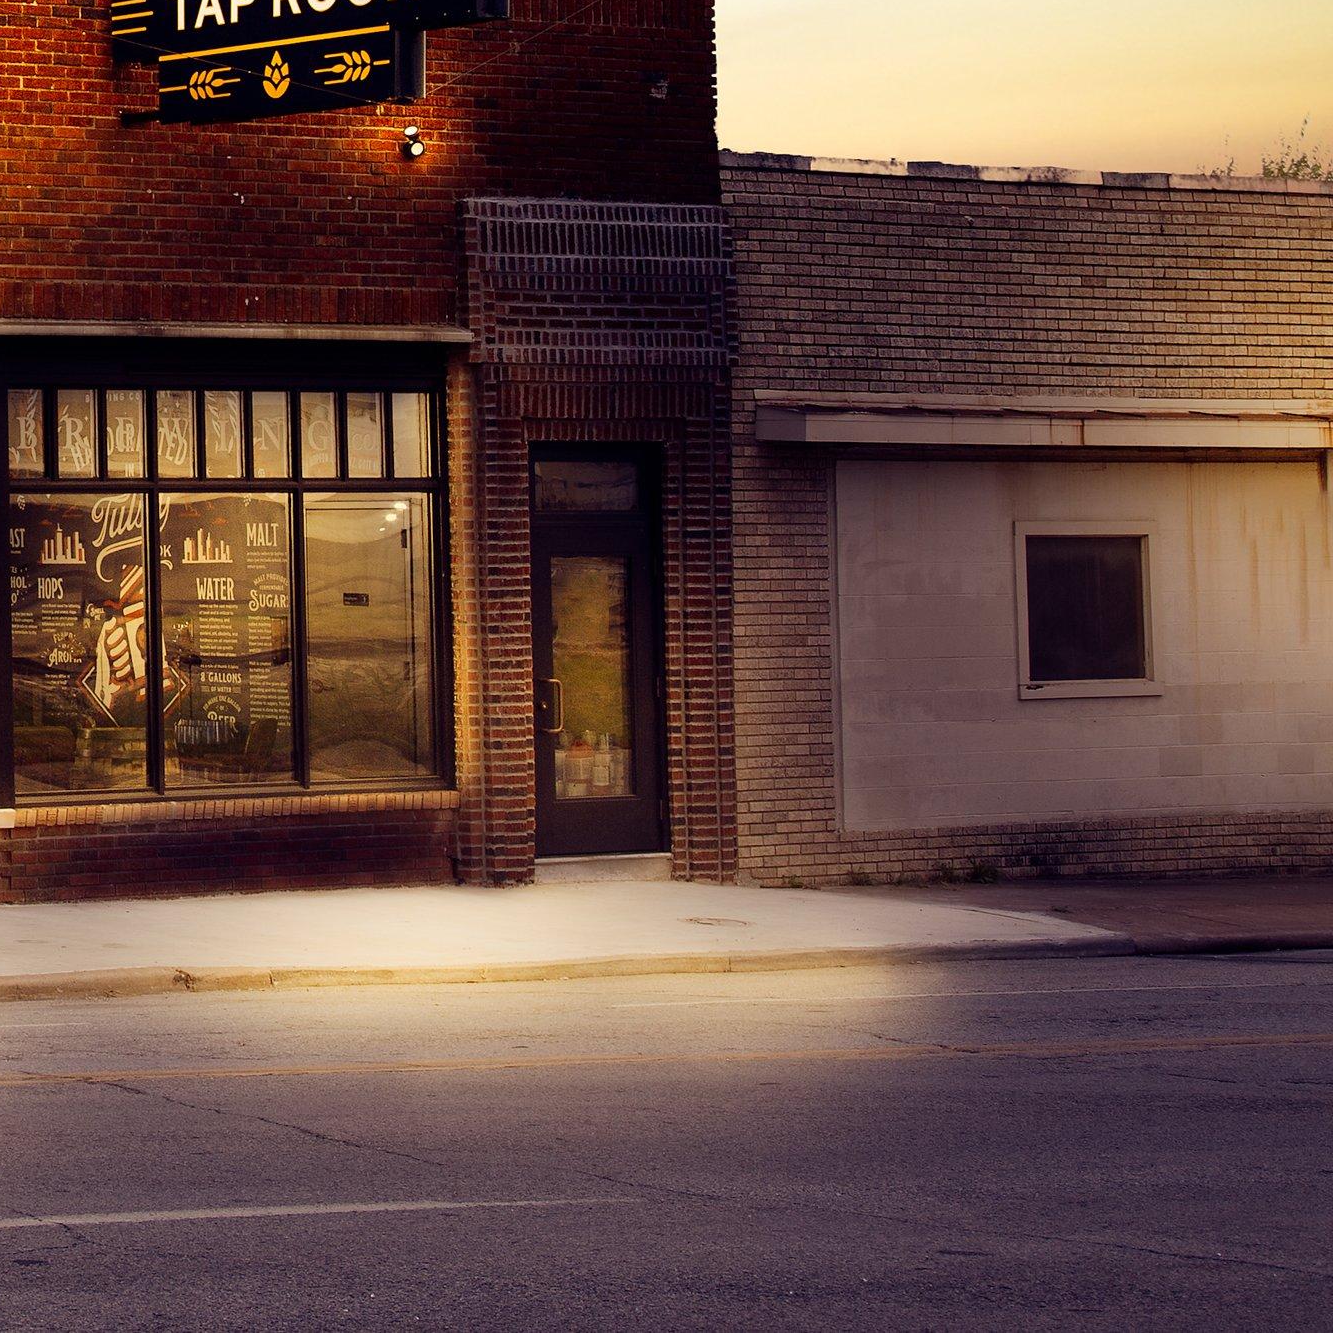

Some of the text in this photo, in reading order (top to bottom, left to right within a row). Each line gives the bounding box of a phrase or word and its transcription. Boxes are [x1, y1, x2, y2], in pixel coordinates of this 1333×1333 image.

[16, 416, 333, 451] BREWING
[245, 522, 279, 547] MALT
[37, 577, 64, 600] HOPS
[196, 576, 235, 601] WATER
[200, 672, 242, 684] 8 GALLONS
